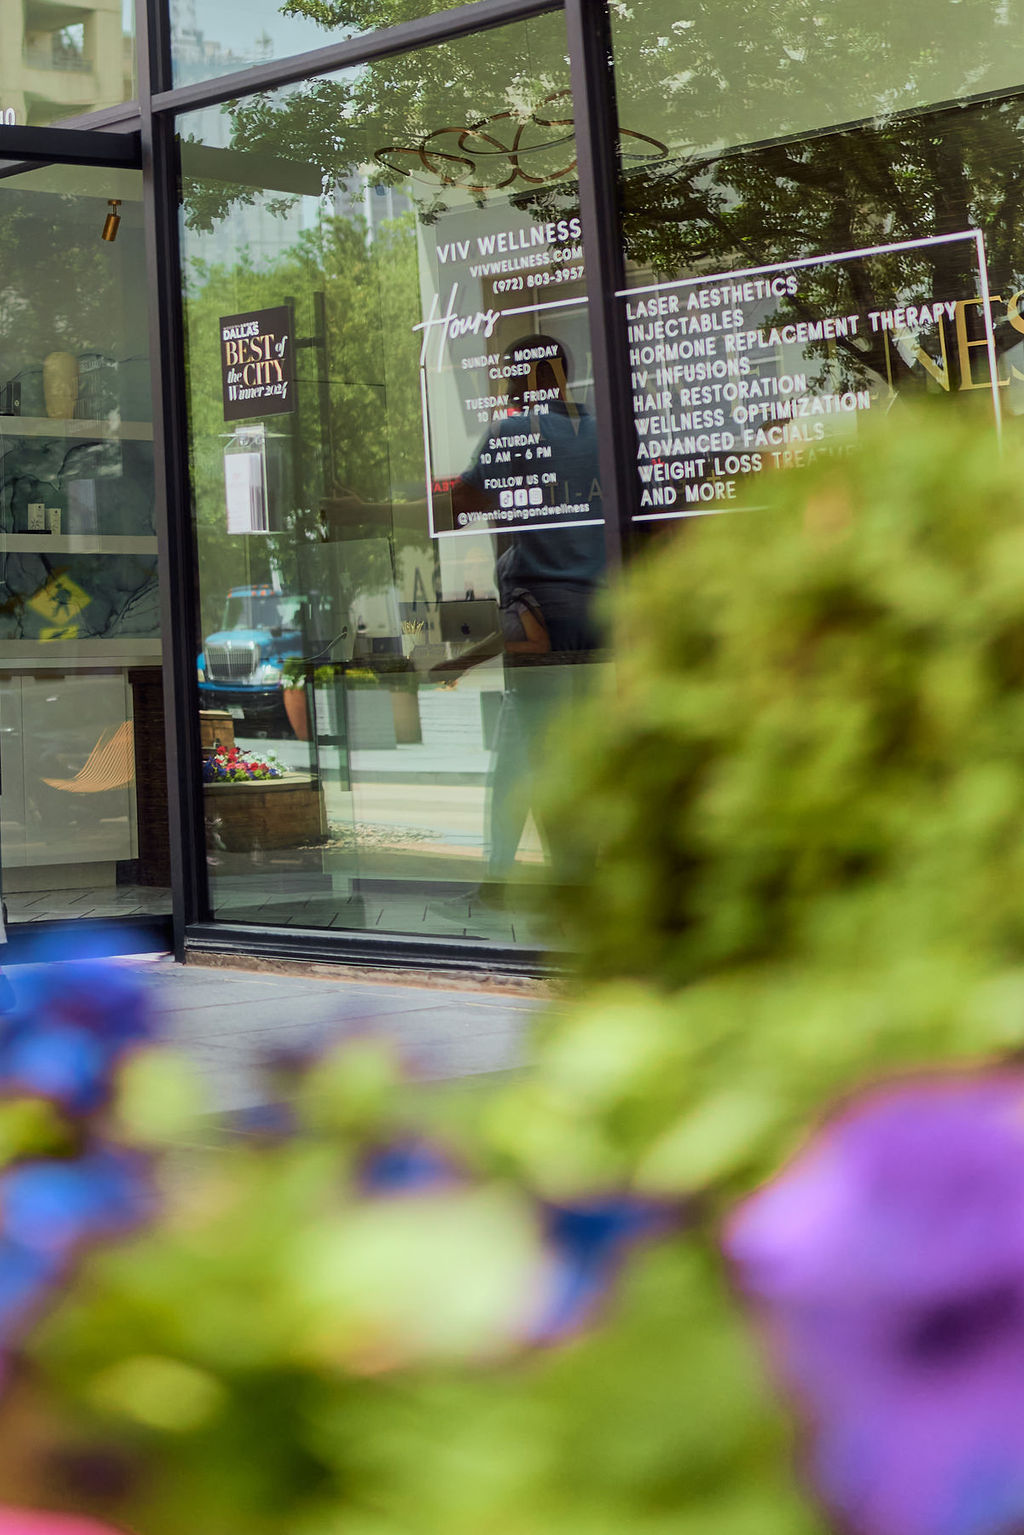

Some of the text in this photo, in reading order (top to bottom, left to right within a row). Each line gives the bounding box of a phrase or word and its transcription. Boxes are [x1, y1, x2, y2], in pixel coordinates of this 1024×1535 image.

[437, 217, 583, 264] VIV WELLNESS
[469, 245, 584, 278] VIVWELLNESS.COM
[492, 265, 585, 295] (972) 803-3957
[626, 275, 799, 321] LASER AESTHETICS
[223, 325, 260, 341] DALLAS
[411, 281, 501, 374] Hours
[627, 308, 744, 343] INJECTABLES
[629, 300, 958, 366] HORMONE REPLACEMENT THERAPY
[225, 334, 288, 366] BEST of
[461, 353, 501, 370] SUNDAY
[514, 344, 559, 363] MONDAY
[227, 358, 286, 386] the CITY
[489, 363, 531, 380] CLOSED
[631, 355, 751, 390] IV INFUSIONS
[228, 381, 288, 402] Winner 2024
[464, 394, 510, 411] TUESDAY
[523, 387, 560, 403] FRIDAY
[632, 373, 807, 413] HAIR RESTORATION
[478, 410, 489, 423] 10
[492, 408, 509, 422] AM
[523, 405, 530, 418] 7
[533, 403, 549, 417] PM
[634, 390, 871, 436] WELLNESS OPTIMIZATION
[480, 452, 492, 465] 10
[494, 449, 511, 464] AM
[525, 447, 533, 460] 6
[536, 446, 552, 459] PM
[489, 432, 541, 450] SATURDAY
[636, 422, 825, 460] ADVANCED FACIALS
[484, 471, 557, 490] FOLLOW US ON
[637, 458, 706, 483] WEIGHT
[714, 453, 763, 476] LOSS
[640, 481, 737, 507] AND MORE
